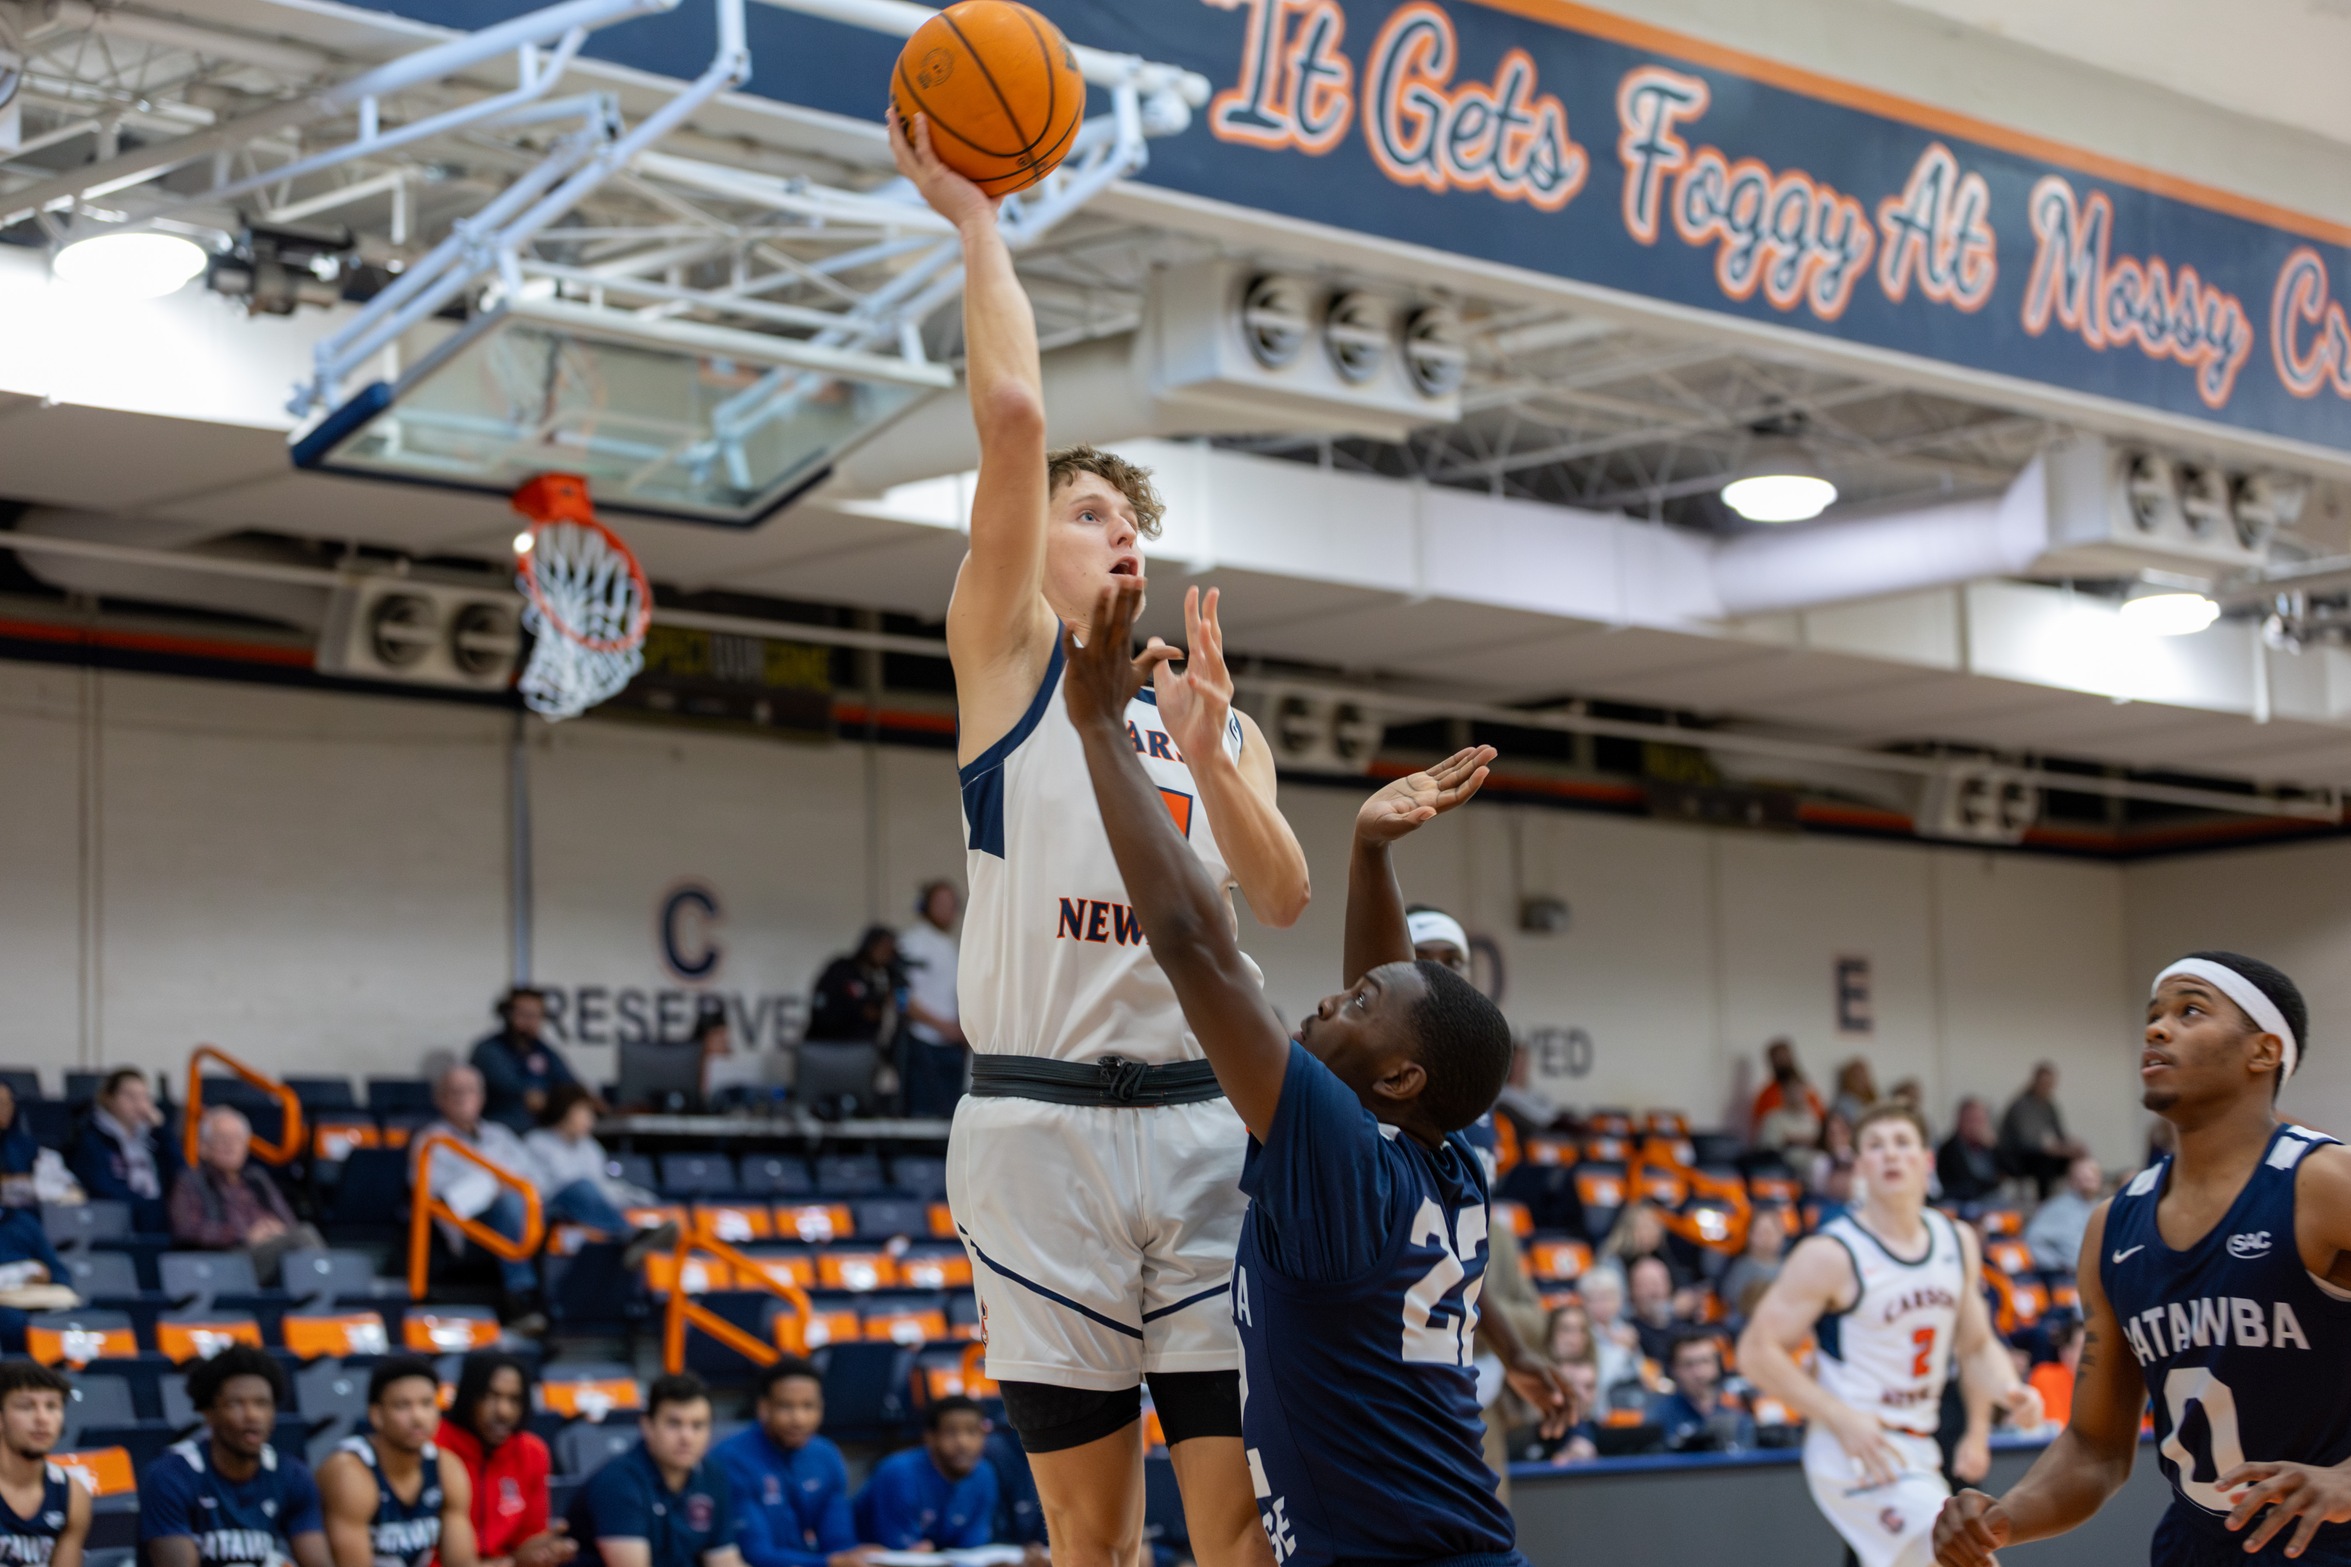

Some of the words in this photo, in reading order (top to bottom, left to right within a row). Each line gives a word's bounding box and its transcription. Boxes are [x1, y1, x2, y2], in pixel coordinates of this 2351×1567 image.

[1208, 0, 1356, 156] It
[1362, 0, 1588, 212] Gets
[1617, 66, 1872, 322] Foggy
[1878, 142, 1997, 314] At
[2021, 175, 2254, 409] Mossy
[656, 877, 722, 982] C
[1834, 951, 1876, 1036] E
[1911, 1325, 1937, 1379] 2
[2160, 1366, 2252, 1513] 0
